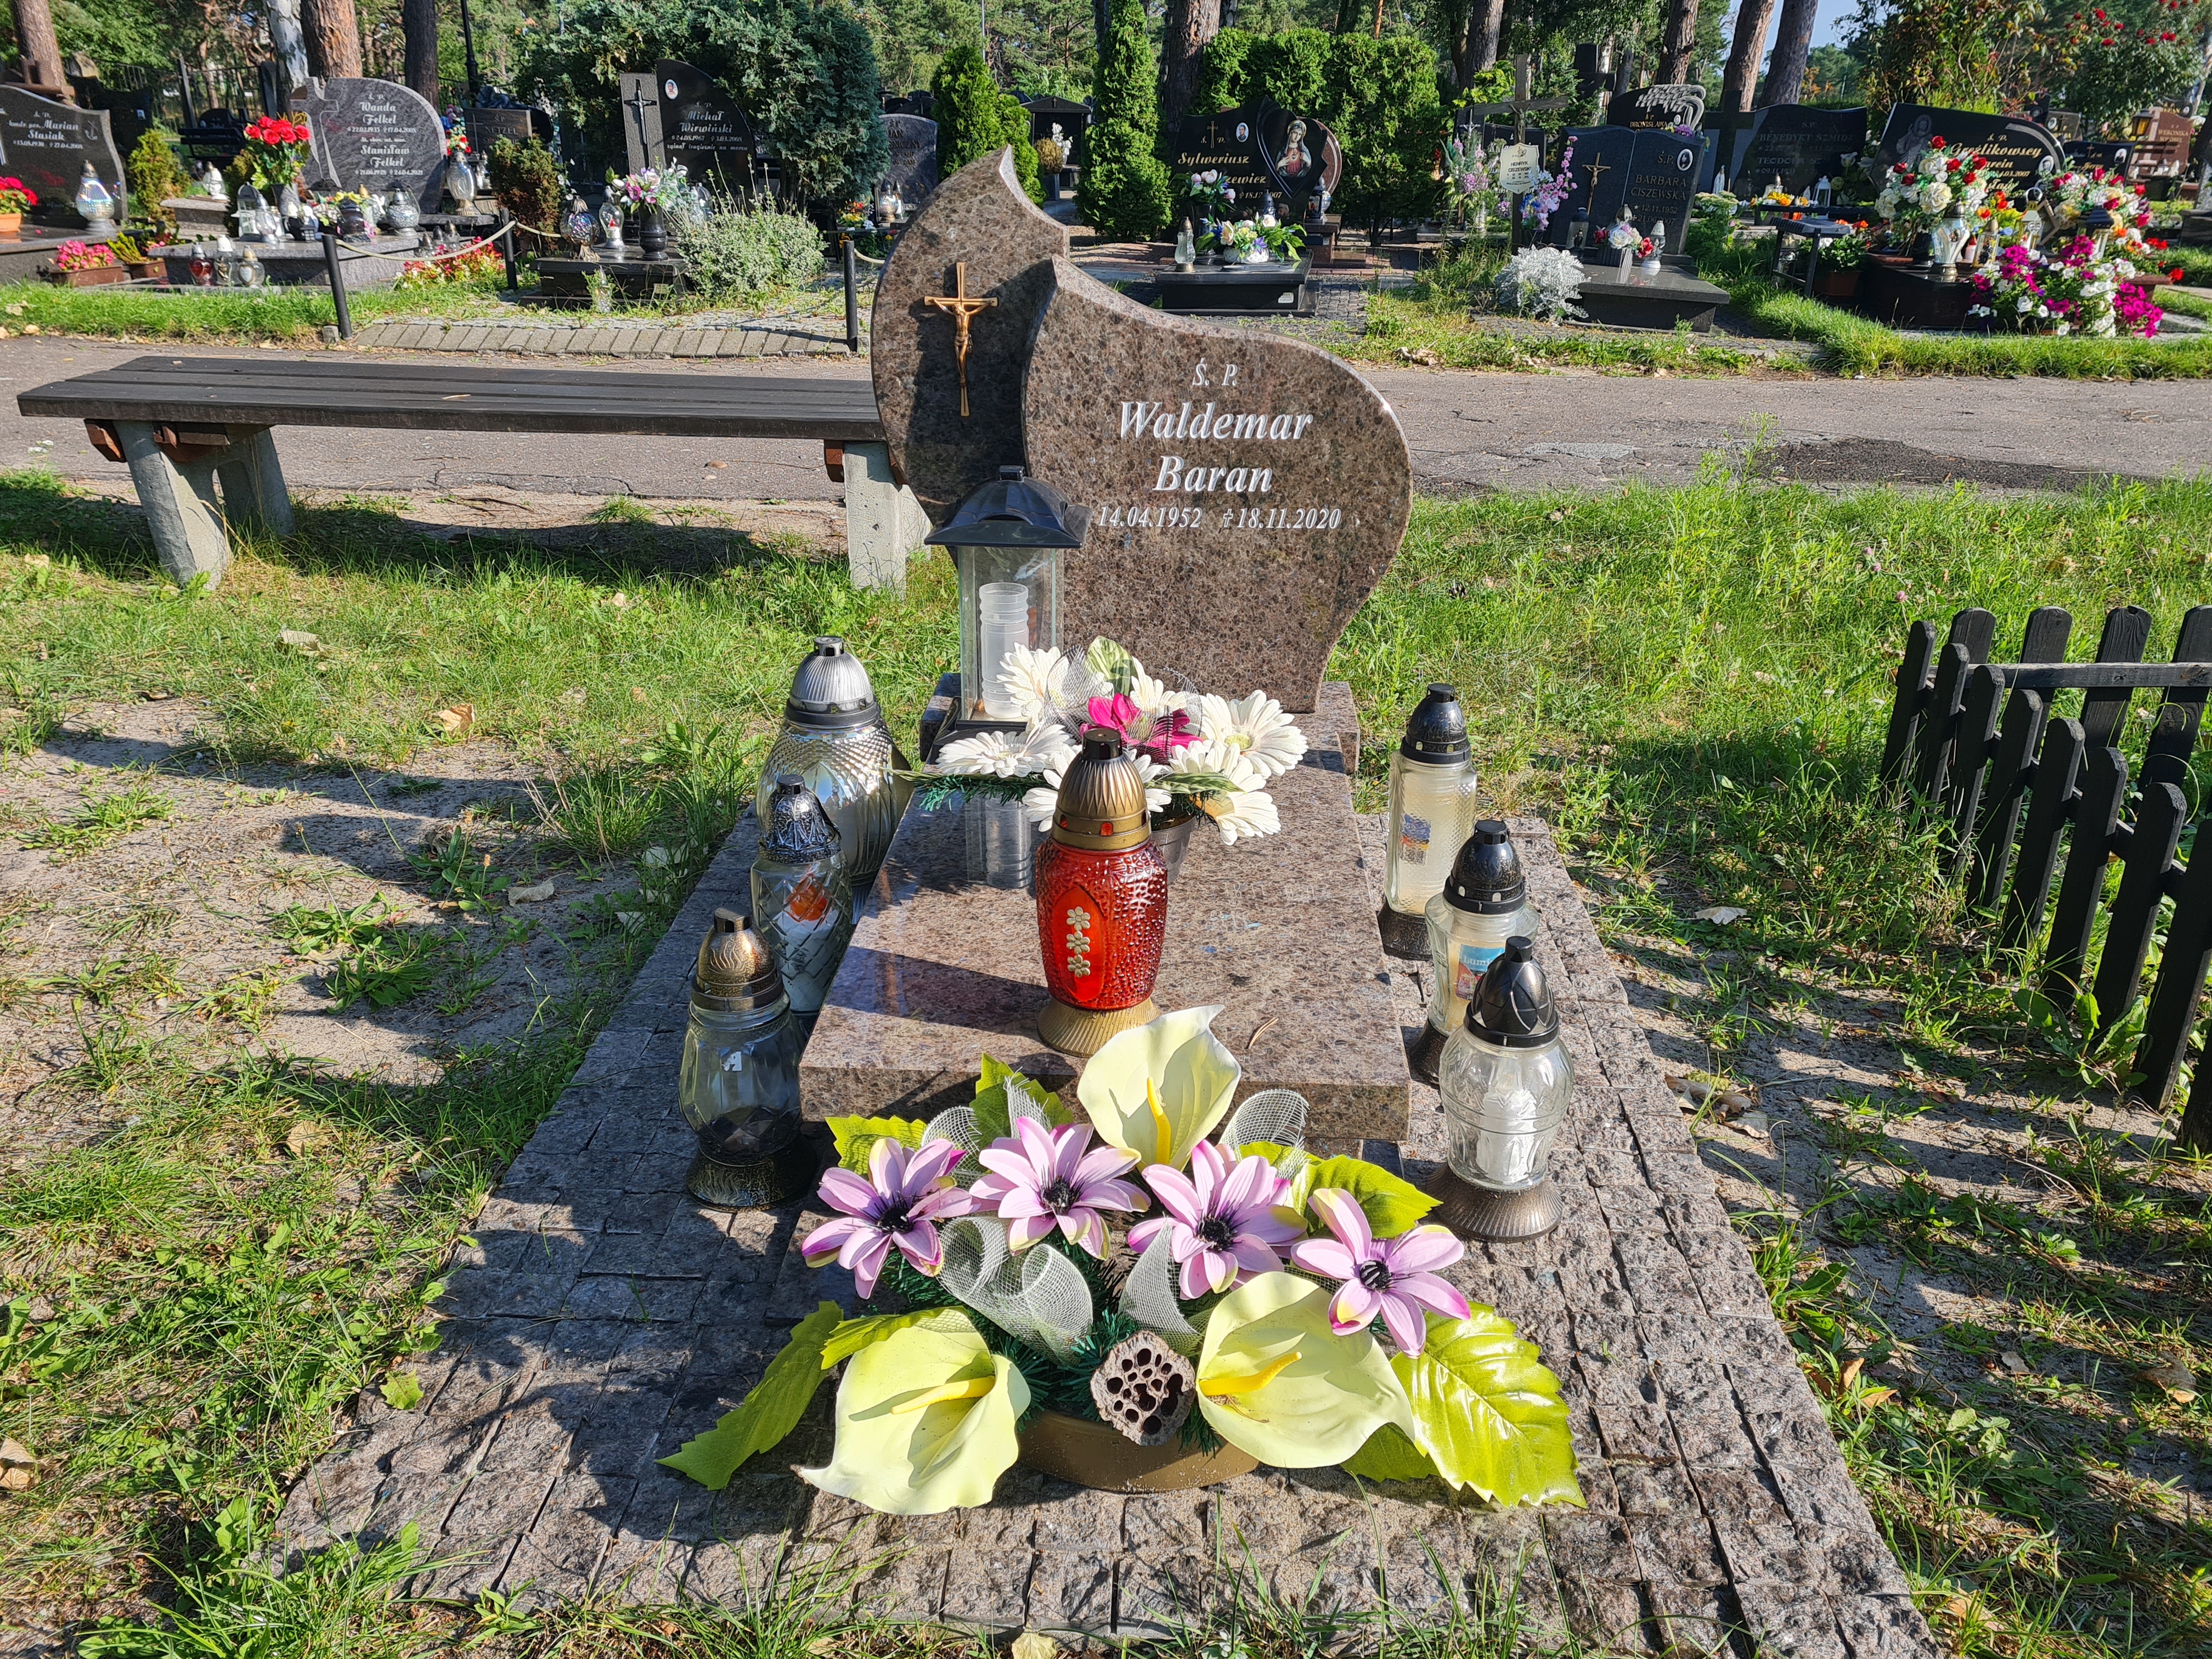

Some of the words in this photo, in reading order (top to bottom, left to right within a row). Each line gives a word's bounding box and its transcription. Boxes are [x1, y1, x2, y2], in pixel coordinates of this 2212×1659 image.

[359, 101, 396, 112] Wanda
[363, 114, 396, 125] Felkel
[685, 110, 725, 121] Michał
[42, 120, 79, 130] Marian
[486, 126, 518, 134] NETZEL
[679, 122, 733, 133] Wirwiński
[28, 129, 65, 140] Stasiak
[360, 145, 410, 155] Stanisław
[667, 143, 686, 151] zginął
[370, 157, 404, 168] Felkel
[1178, 152, 1250, 166] Sylweriusz
[1635, 174, 1687, 187] BARBARA
[1631, 187, 1686, 201] CISZEWSKA
[1193, 358, 1210, 386] Ś.
[1222, 363, 1239, 386] P.
[1120, 400, 1314, 440] Waldemar
[1152, 455, 1273, 493] Baran
[1097, 505, 1203, 528] 14.04.1952
[1236, 506, 1342, 530] 18.11.2020
[1463, 954, 1492, 966] Lumi
